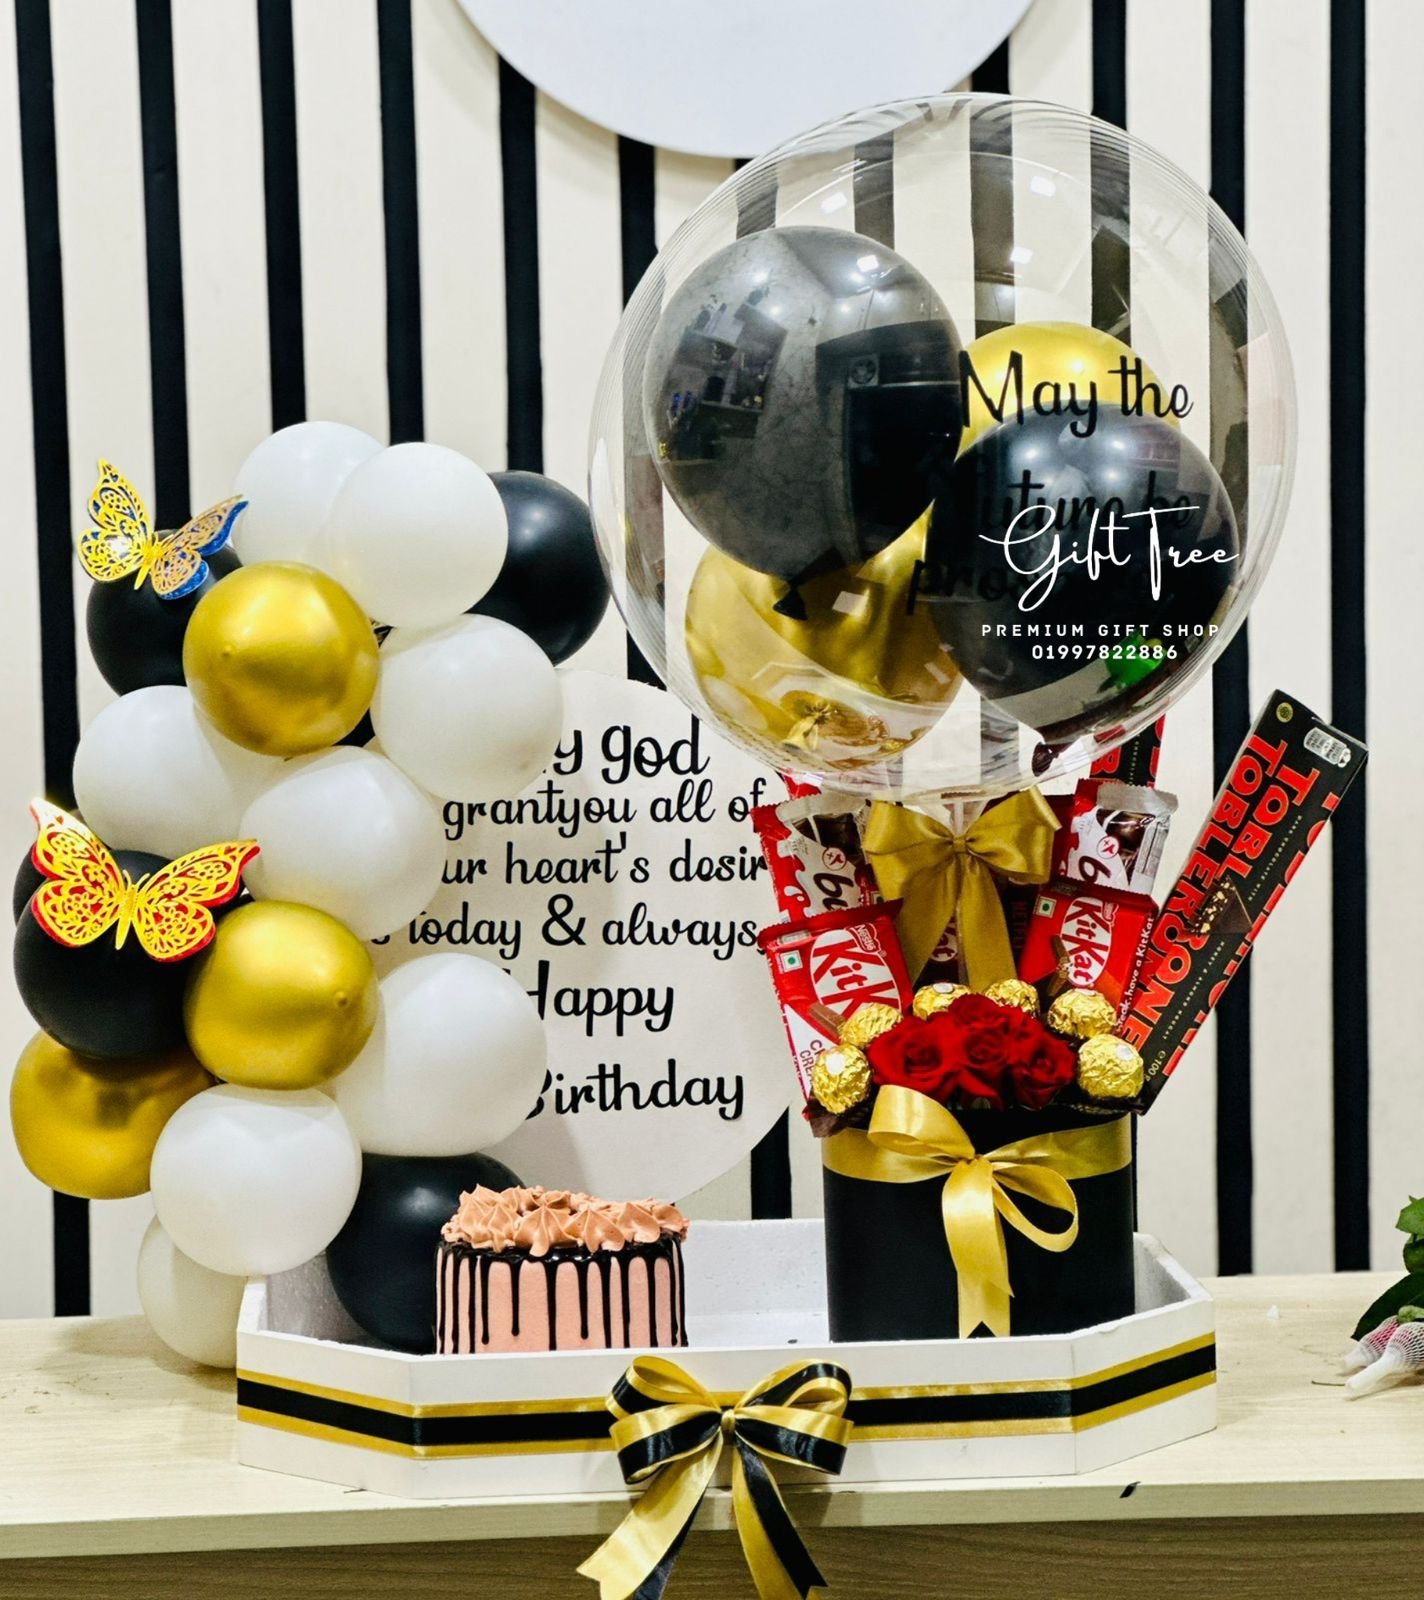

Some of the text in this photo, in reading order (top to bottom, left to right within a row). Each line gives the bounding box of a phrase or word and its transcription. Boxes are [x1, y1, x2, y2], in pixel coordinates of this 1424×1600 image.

[959, 350, 1194, 438] May the
[601, 714, 711, 784] god
[650, 778, 716, 823] all
[505, 831, 650, 884] heart's
[669, 838, 768, 882] desir
[1130, 734, 1288, 1008] TOBLERO
[542, 893, 586, 945] &
[1060, 899, 1111, 983] KitKat
[1122, 767, 1321, 1054] TOBLONE
[1135, 917, 1155, 957] KitKat
[812, 938, 900, 1020] KitK
